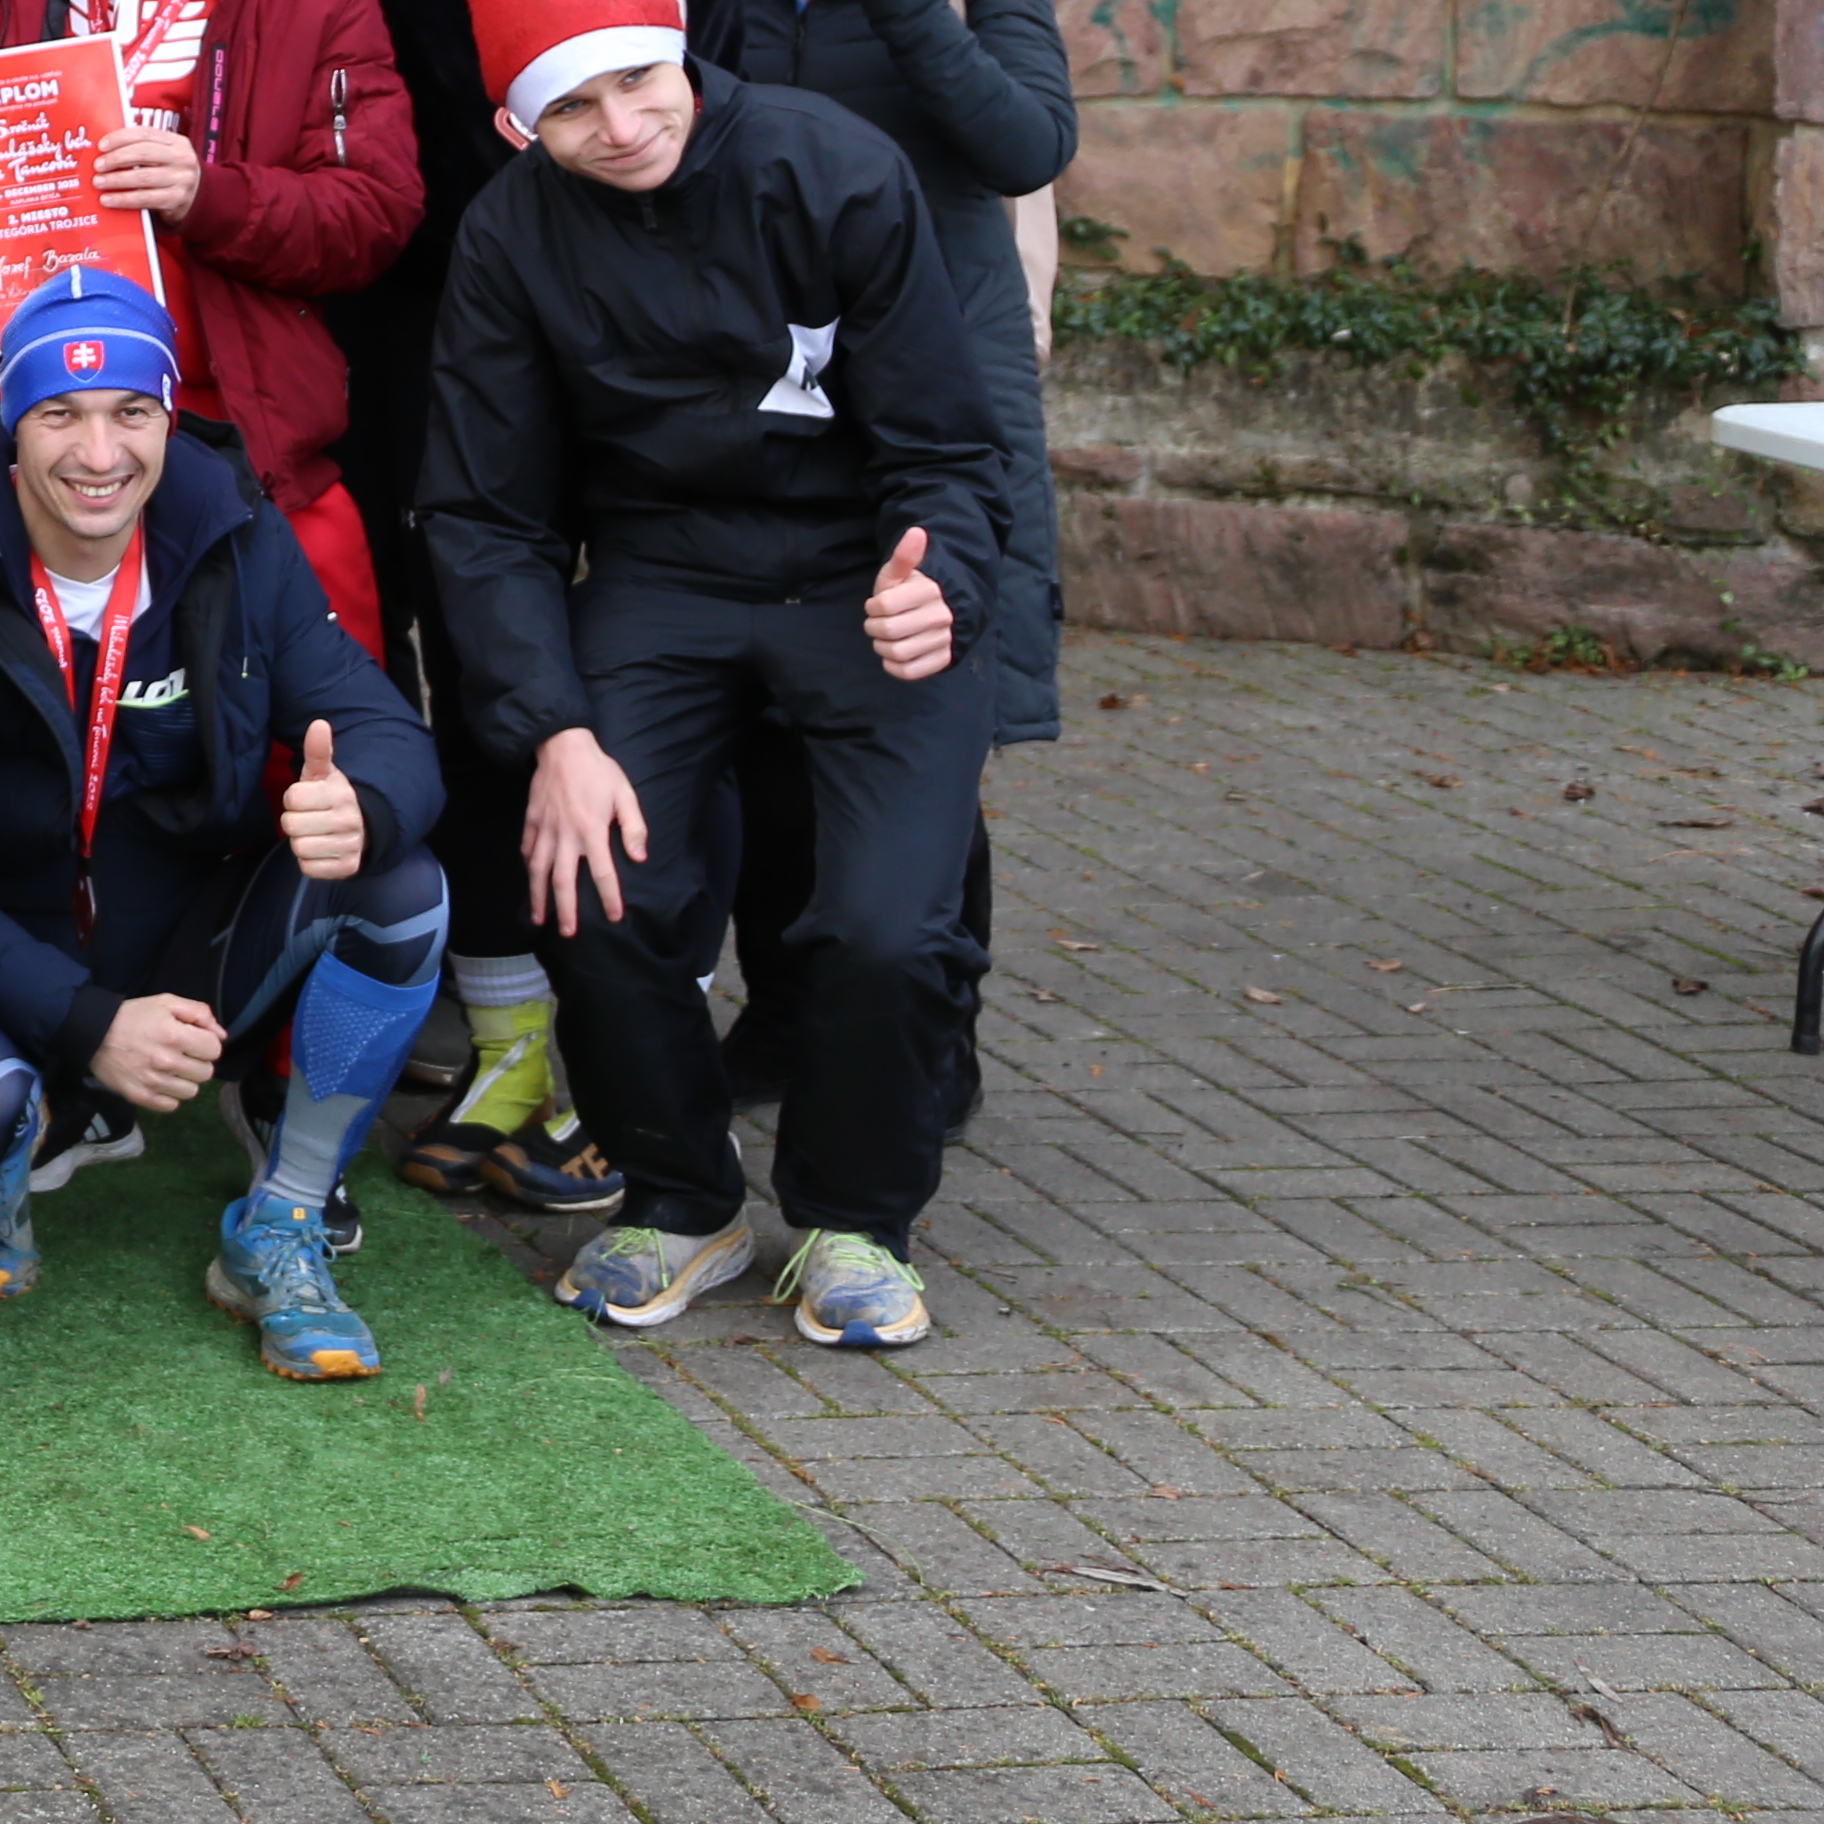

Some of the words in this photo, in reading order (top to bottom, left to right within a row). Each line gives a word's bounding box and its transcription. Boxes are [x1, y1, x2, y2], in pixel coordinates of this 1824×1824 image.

[4, 182, 56, 198] DECEMBER
[56, 178, 80, 190] 2025
[7, 214, 19, 225] 2.
[20, 205, 68, 222] MIESTO
[49, 213, 98, 230] TROJICE
